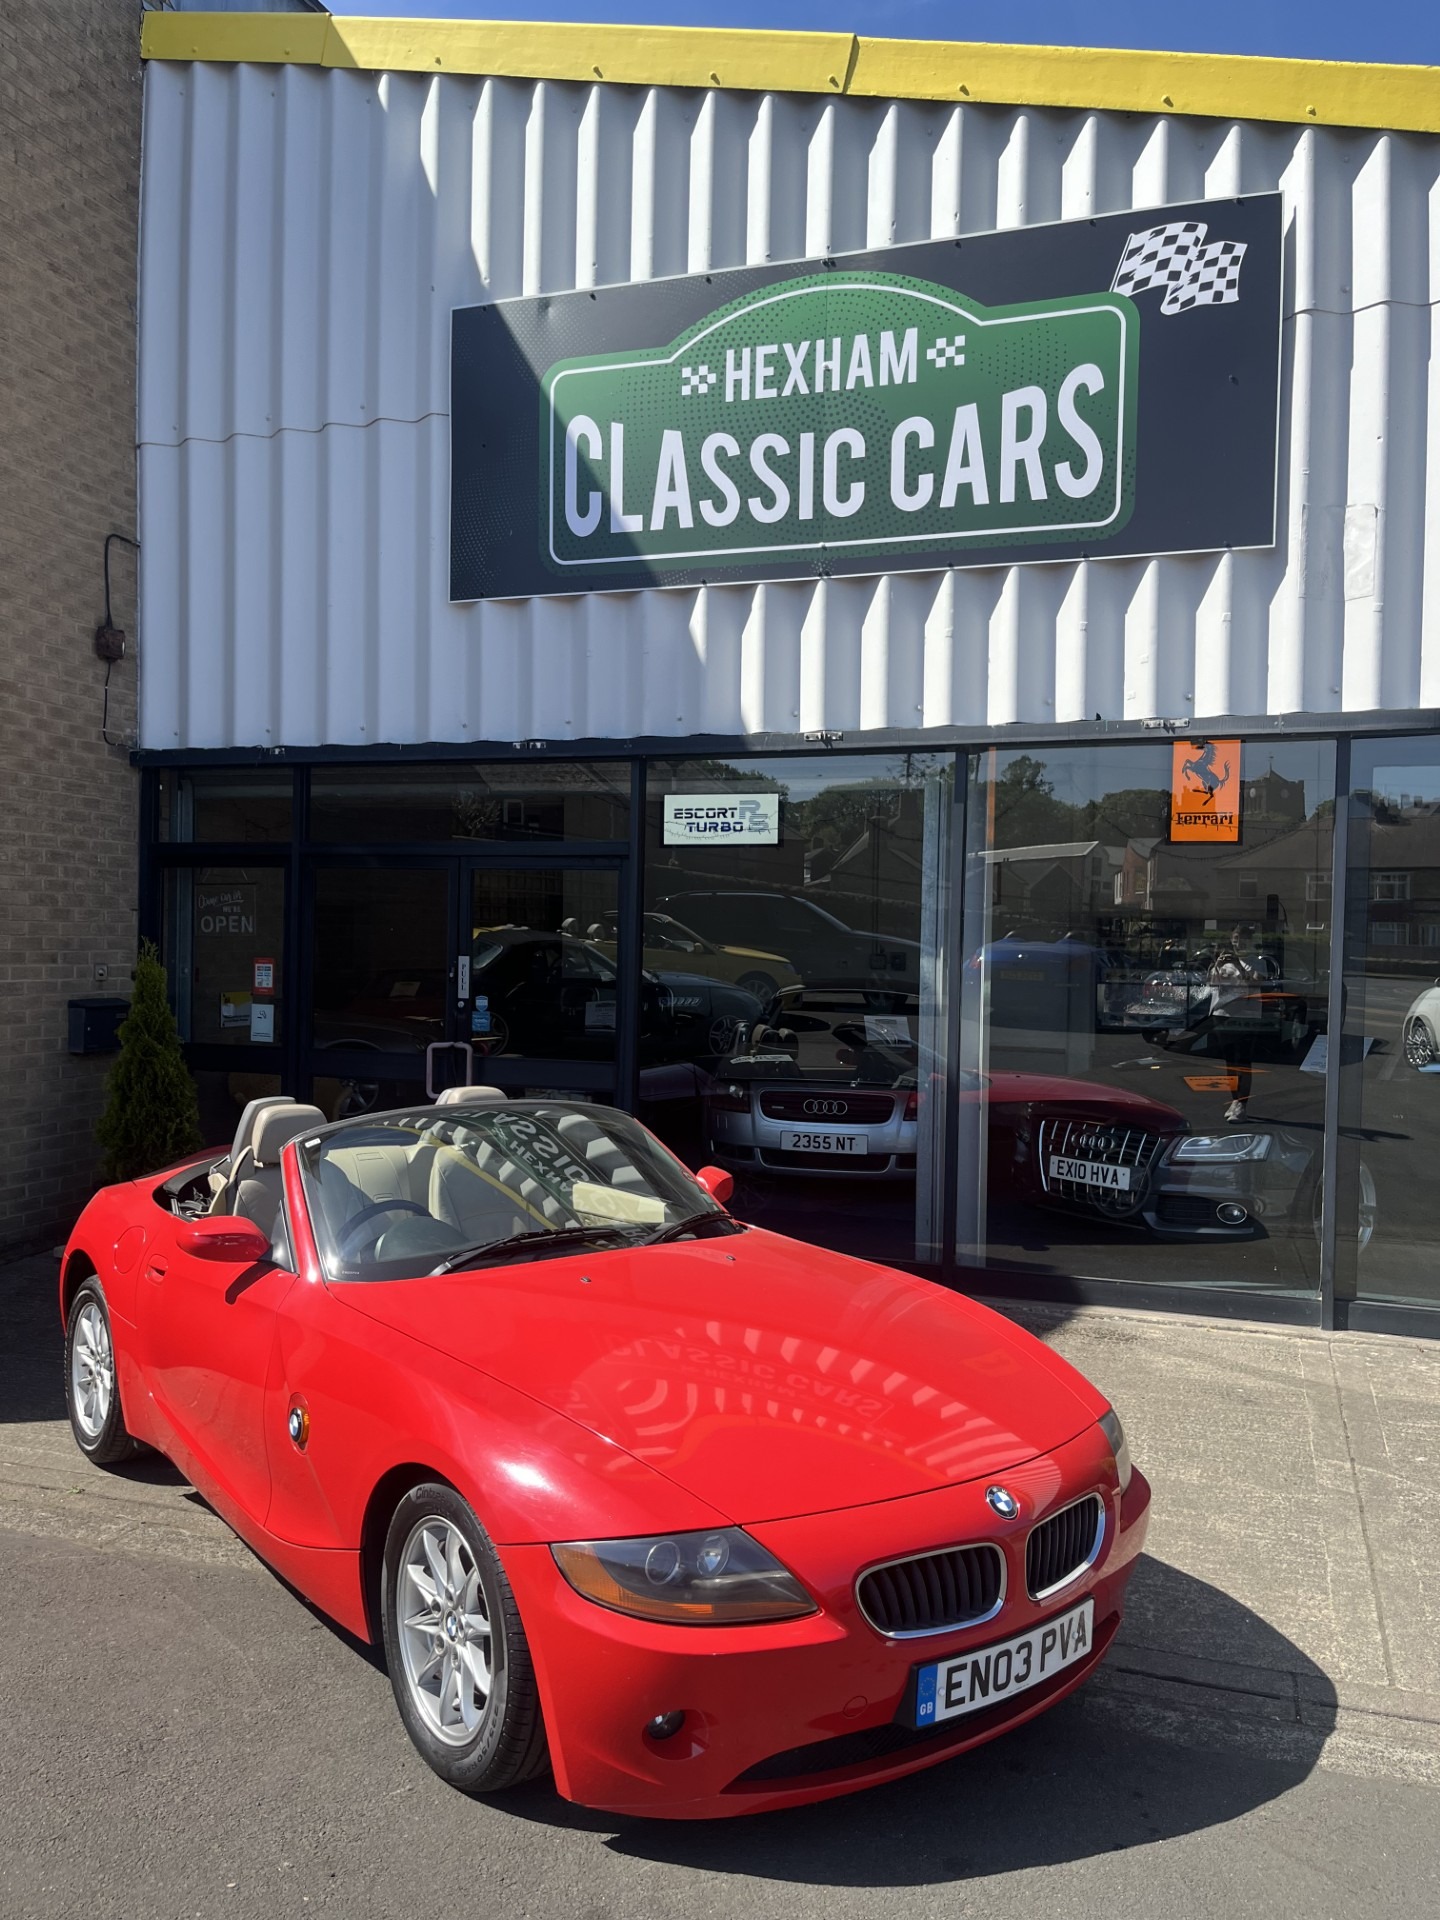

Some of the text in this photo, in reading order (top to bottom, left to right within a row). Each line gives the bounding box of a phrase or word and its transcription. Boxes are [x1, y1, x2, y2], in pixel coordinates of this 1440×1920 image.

[725, 327, 919, 403] HEXHAM
[564, 362, 1106, 538] CLASSIC CARS
[673, 807, 738, 820] ESCORT
[686, 821, 744, 833] TURBO
[200, 915, 254, 933] OPEN
[792, 1134, 856, 1151] 2355 NT
[1056, 1159, 1119, 1186] EX10 HVA
[944, 1610, 1087, 1710] EN03 PVA
[919, 1701, 933, 1716] GB
